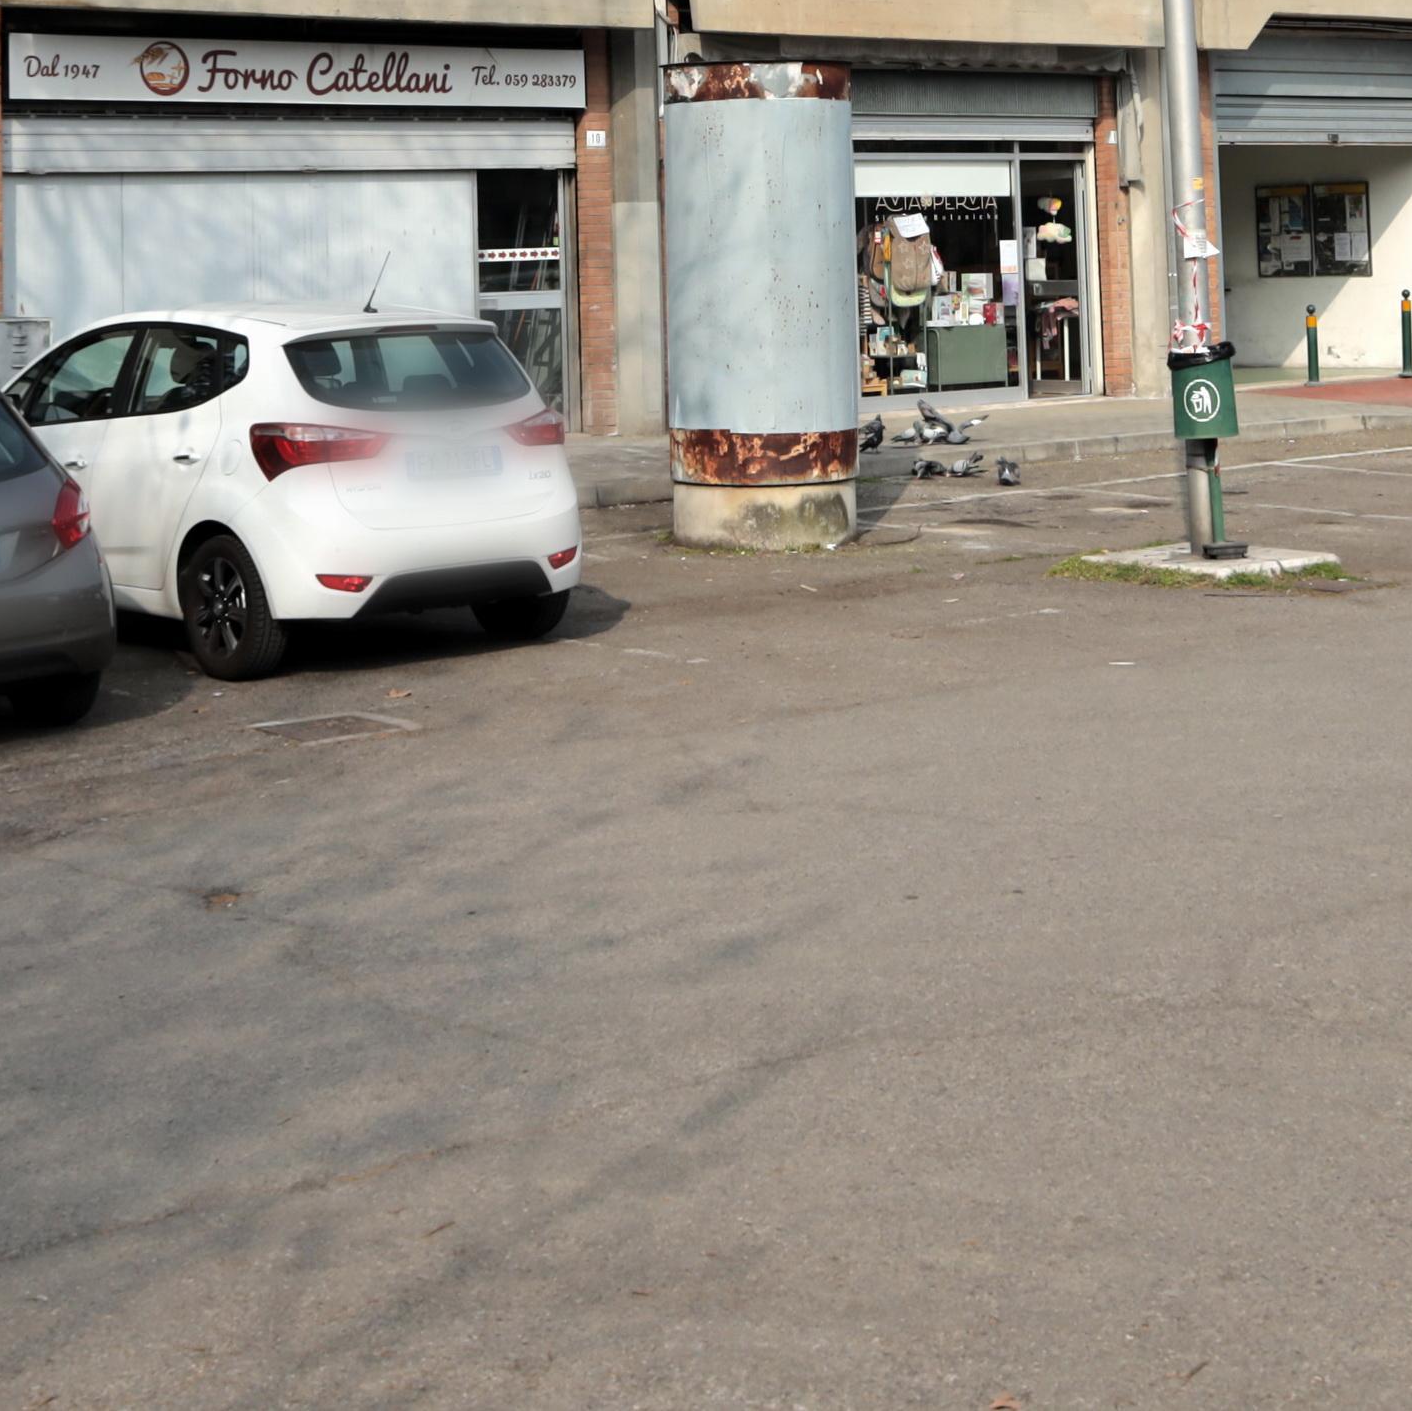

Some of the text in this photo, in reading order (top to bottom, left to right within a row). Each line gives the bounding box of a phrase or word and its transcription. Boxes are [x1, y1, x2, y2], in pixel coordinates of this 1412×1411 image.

[23, 54, 100, 79] Dal 1947
[197, 49, 453, 96] Forno Catellani
[471, 65, 577, 88] Tel. 059 283379
[590, 133, 601, 145] 10
